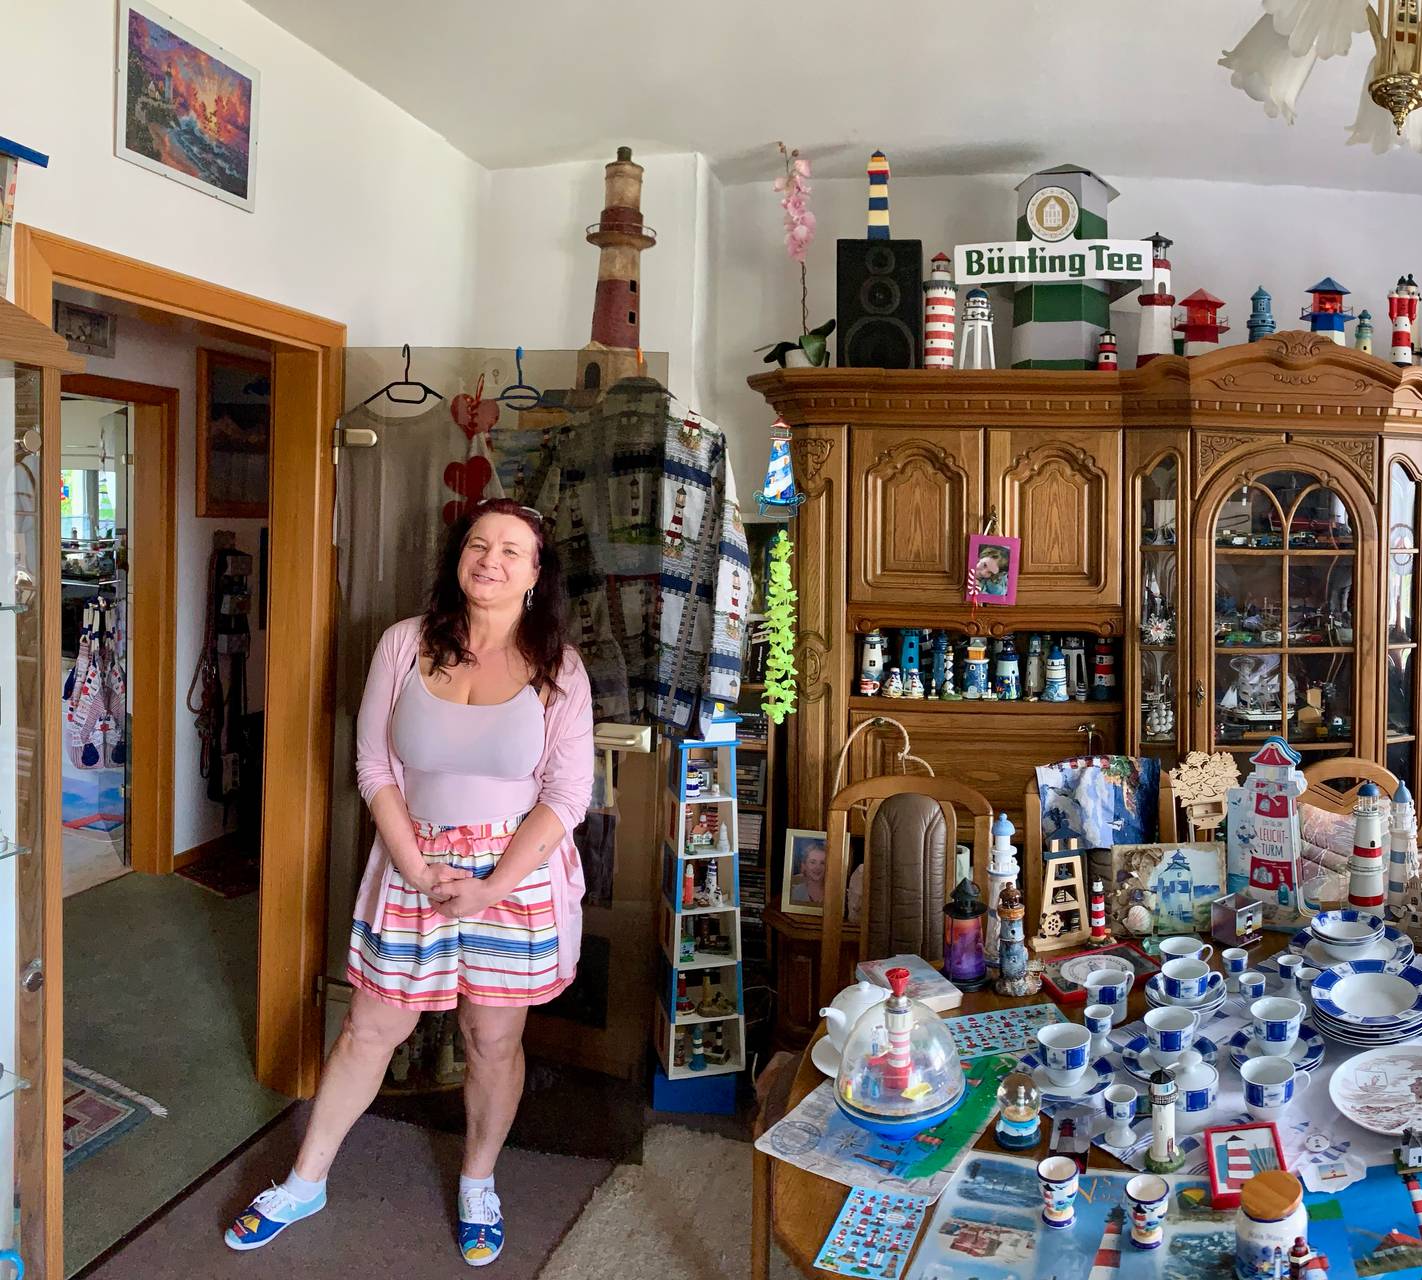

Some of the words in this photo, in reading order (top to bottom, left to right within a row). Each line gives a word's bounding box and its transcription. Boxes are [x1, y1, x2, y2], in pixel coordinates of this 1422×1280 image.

[965, 247, 1086, 277] Bünting
[1088, 245, 1143, 271] Tee
[1262, 843, 1284, 858] TURM
